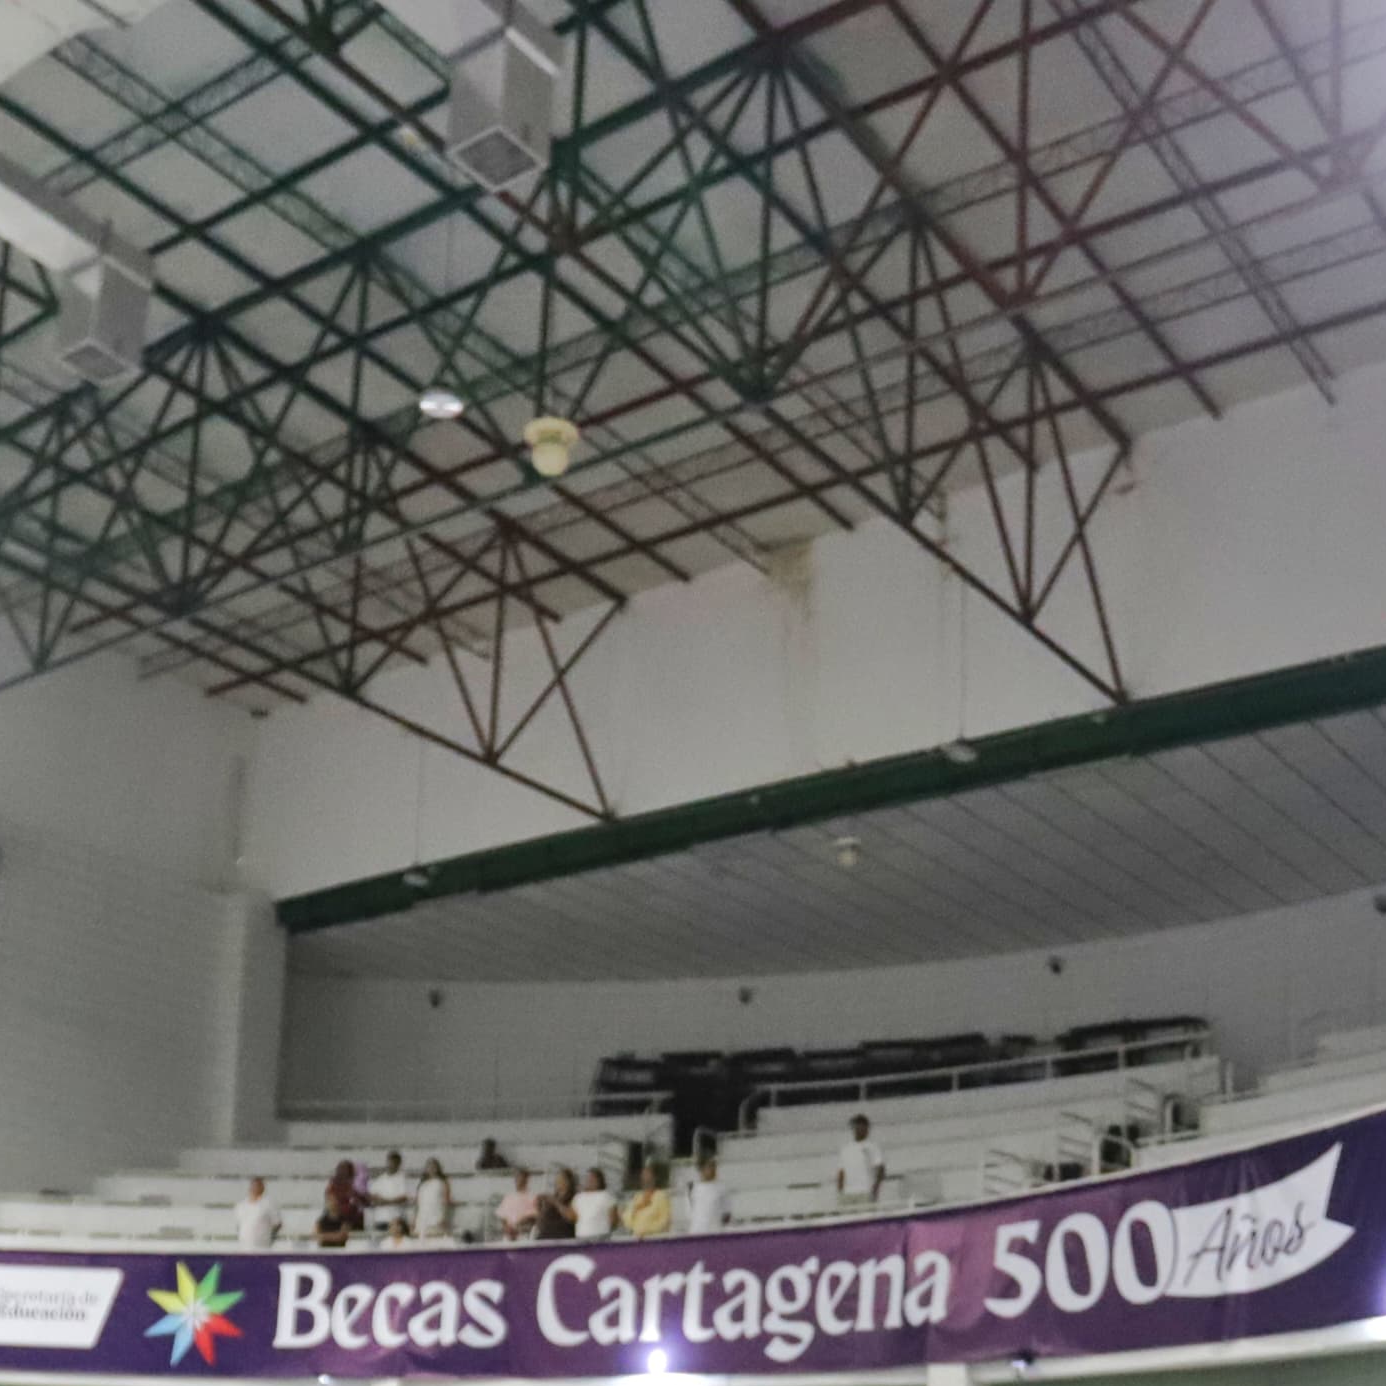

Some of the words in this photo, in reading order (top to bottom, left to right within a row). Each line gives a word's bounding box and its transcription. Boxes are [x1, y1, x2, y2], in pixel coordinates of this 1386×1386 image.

[272, 1262, 507, 1349] Becas
[536, 1252, 951, 1363] Cartagena
[983, 1200, 1170, 1318] 500
[1183, 1203, 1313, 1287] Años
